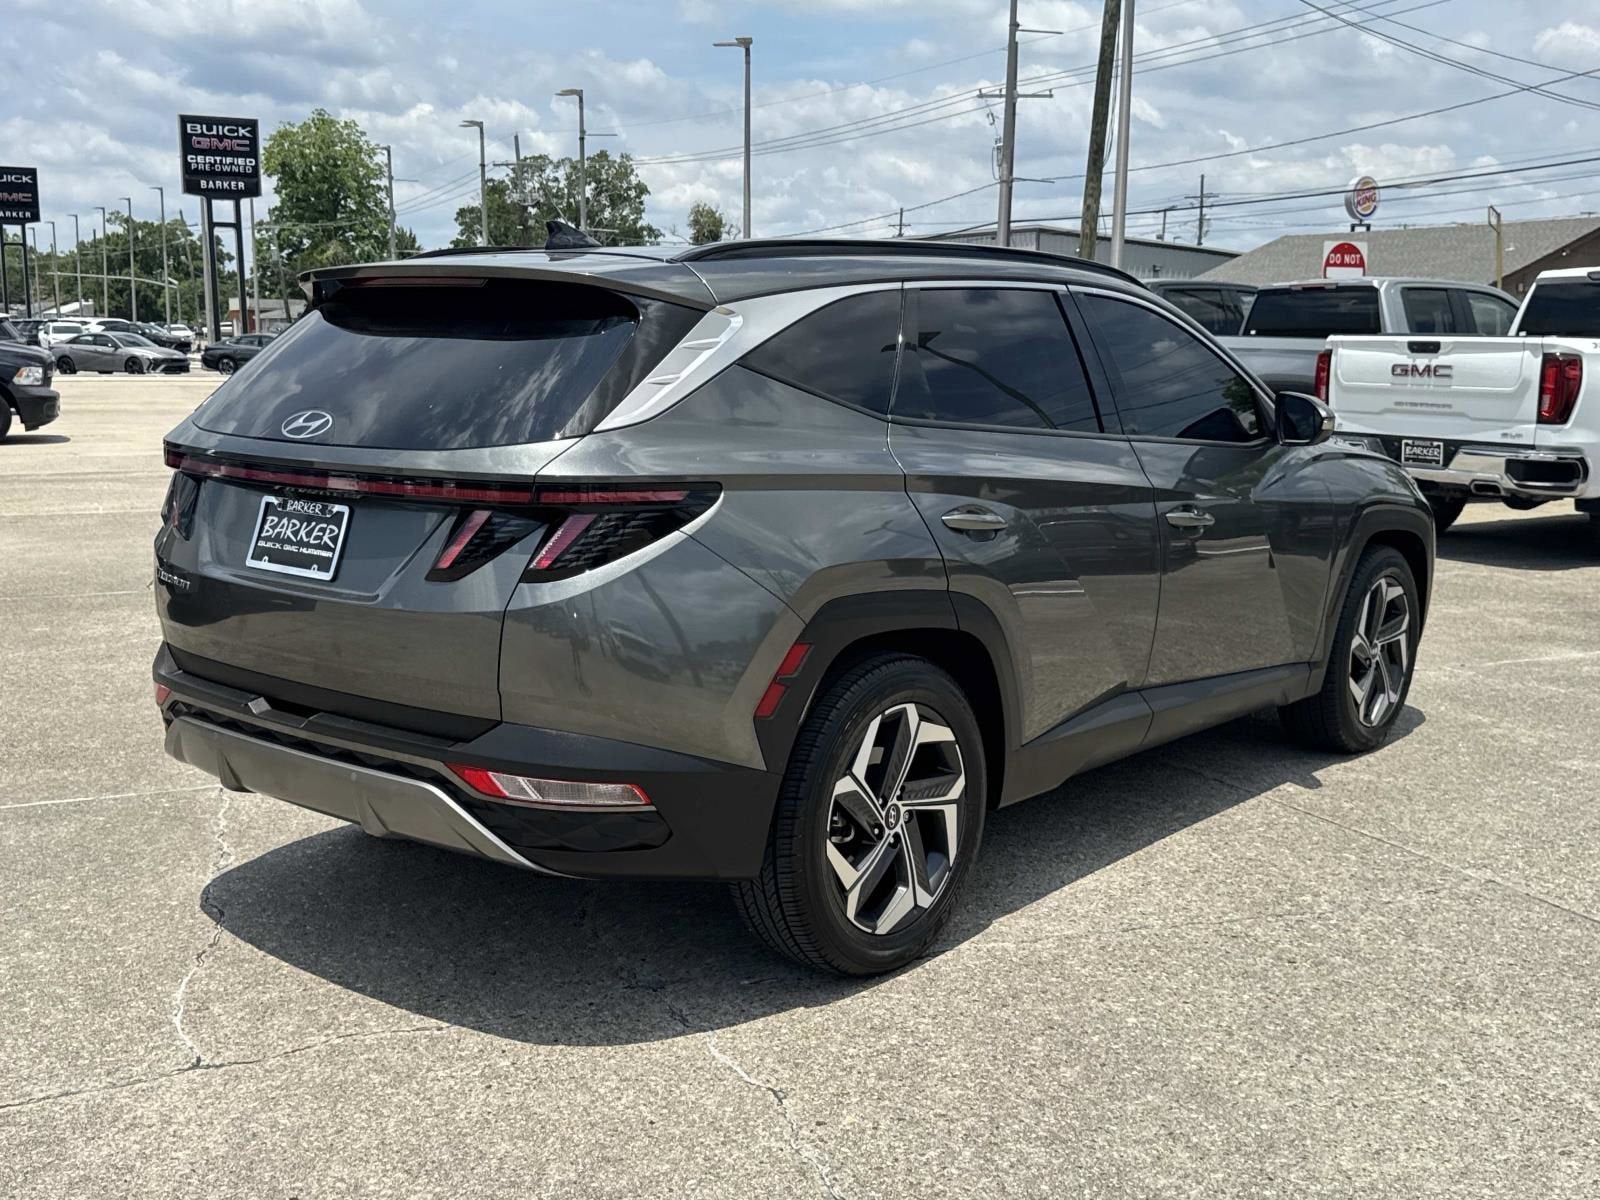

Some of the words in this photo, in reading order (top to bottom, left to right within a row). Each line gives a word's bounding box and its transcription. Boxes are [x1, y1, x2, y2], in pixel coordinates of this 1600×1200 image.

[186, 123, 253, 138] BUICK
[191, 135, 250, 151] GMC
[187, 155, 256, 166] CERTIFIED
[191, 163, 253, 173] PRE-OWNED
[0, 174, 33, 183] UICK
[200, 179, 245, 190] BARKER
[0, 192, 33, 202] MC
[0, 210, 31, 218] ARKER
[1329, 254, 1341, 264] DO
[1344, 254, 1361, 264] NOT
[1391, 363, 1453, 379] GMC
[1405, 446, 1440, 457] BARKER
[287, 499, 322, 514] BARKER
[261, 516, 339, 548] BARKER
[257, 540, 282, 549] BUICK
[300, 547, 333, 558] HUMMER
